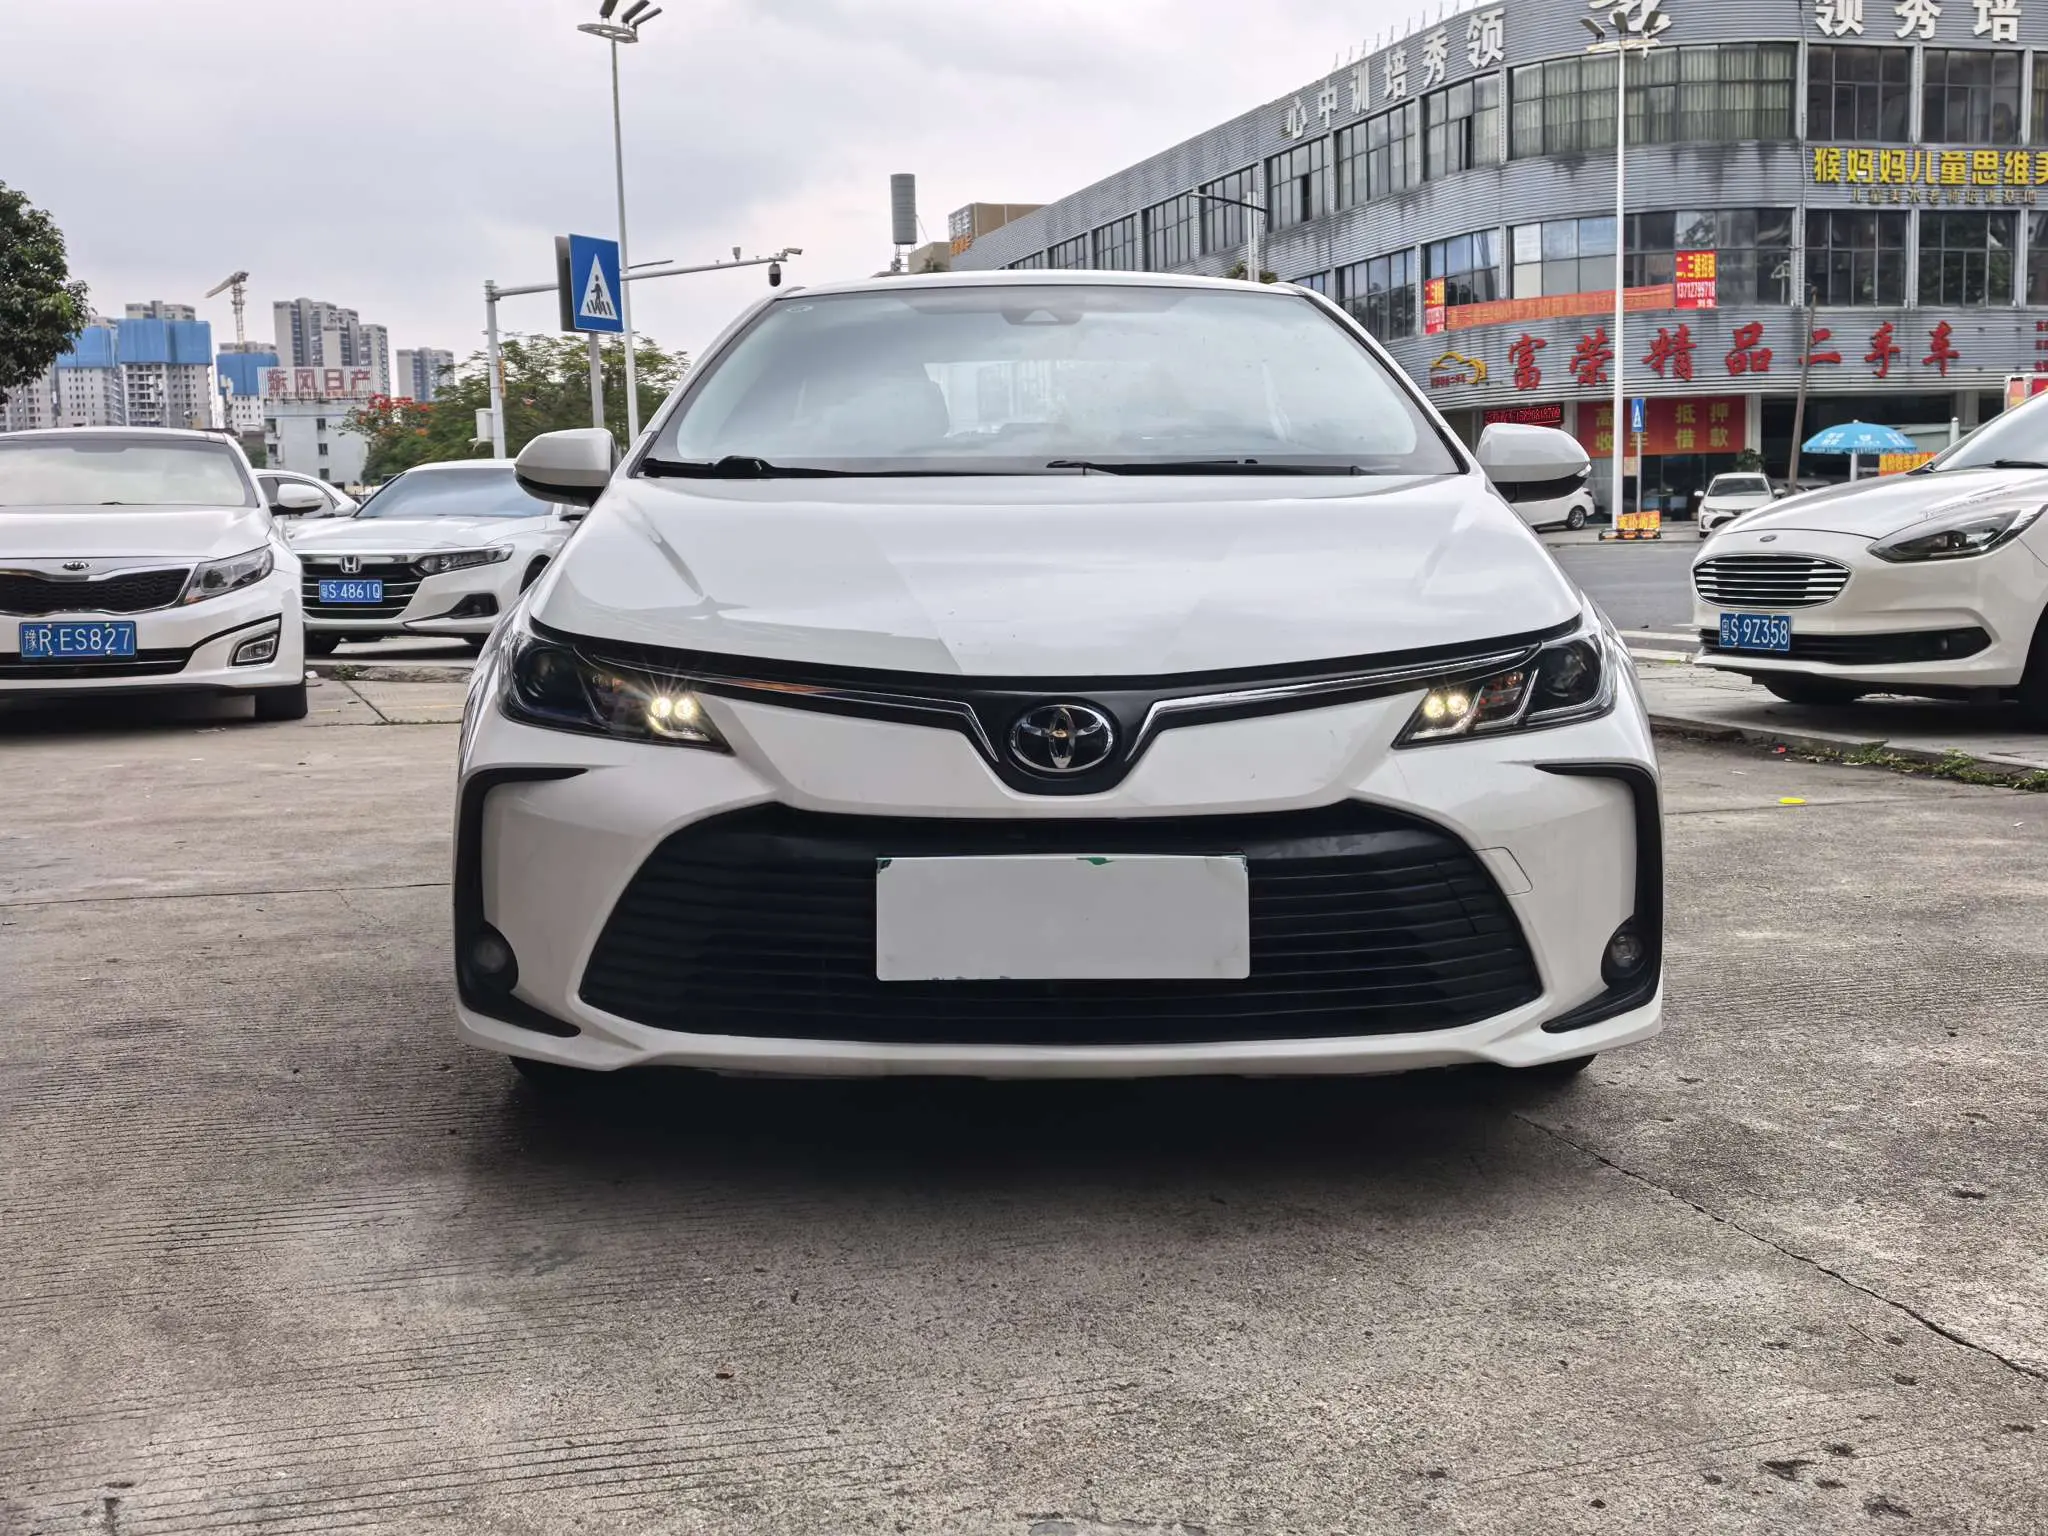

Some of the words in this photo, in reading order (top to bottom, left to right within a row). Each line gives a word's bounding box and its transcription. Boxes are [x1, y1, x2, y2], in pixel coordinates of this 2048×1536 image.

[1507, 320, 1960, 391] 富荣精品二手车
[1675, 403, 1729, 425] 抵押
[1595, 431, 1648, 450] 收车
[1675, 428, 1729, 450] 借款
